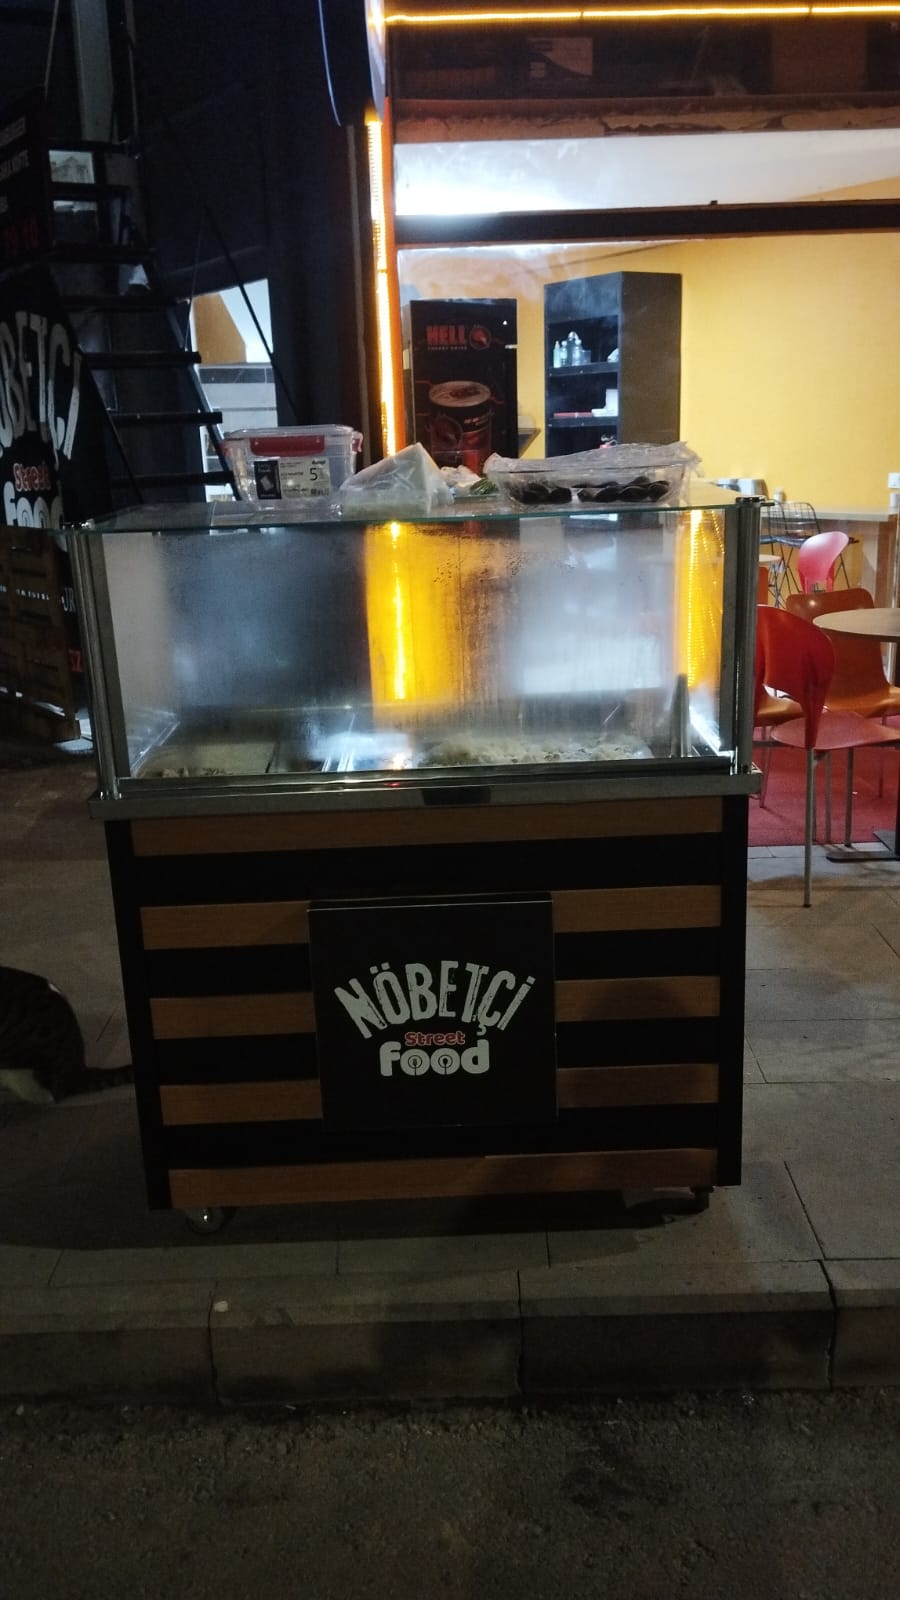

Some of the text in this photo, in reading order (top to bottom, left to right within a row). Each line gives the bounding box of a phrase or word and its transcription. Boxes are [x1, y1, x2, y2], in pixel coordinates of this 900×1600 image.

[427, 325, 467, 345] HELL
[334, 960, 536, 1038] NÖBETÇİ
[404, 1031, 466, 1046] Street
[379, 1039, 490, 1076] food
